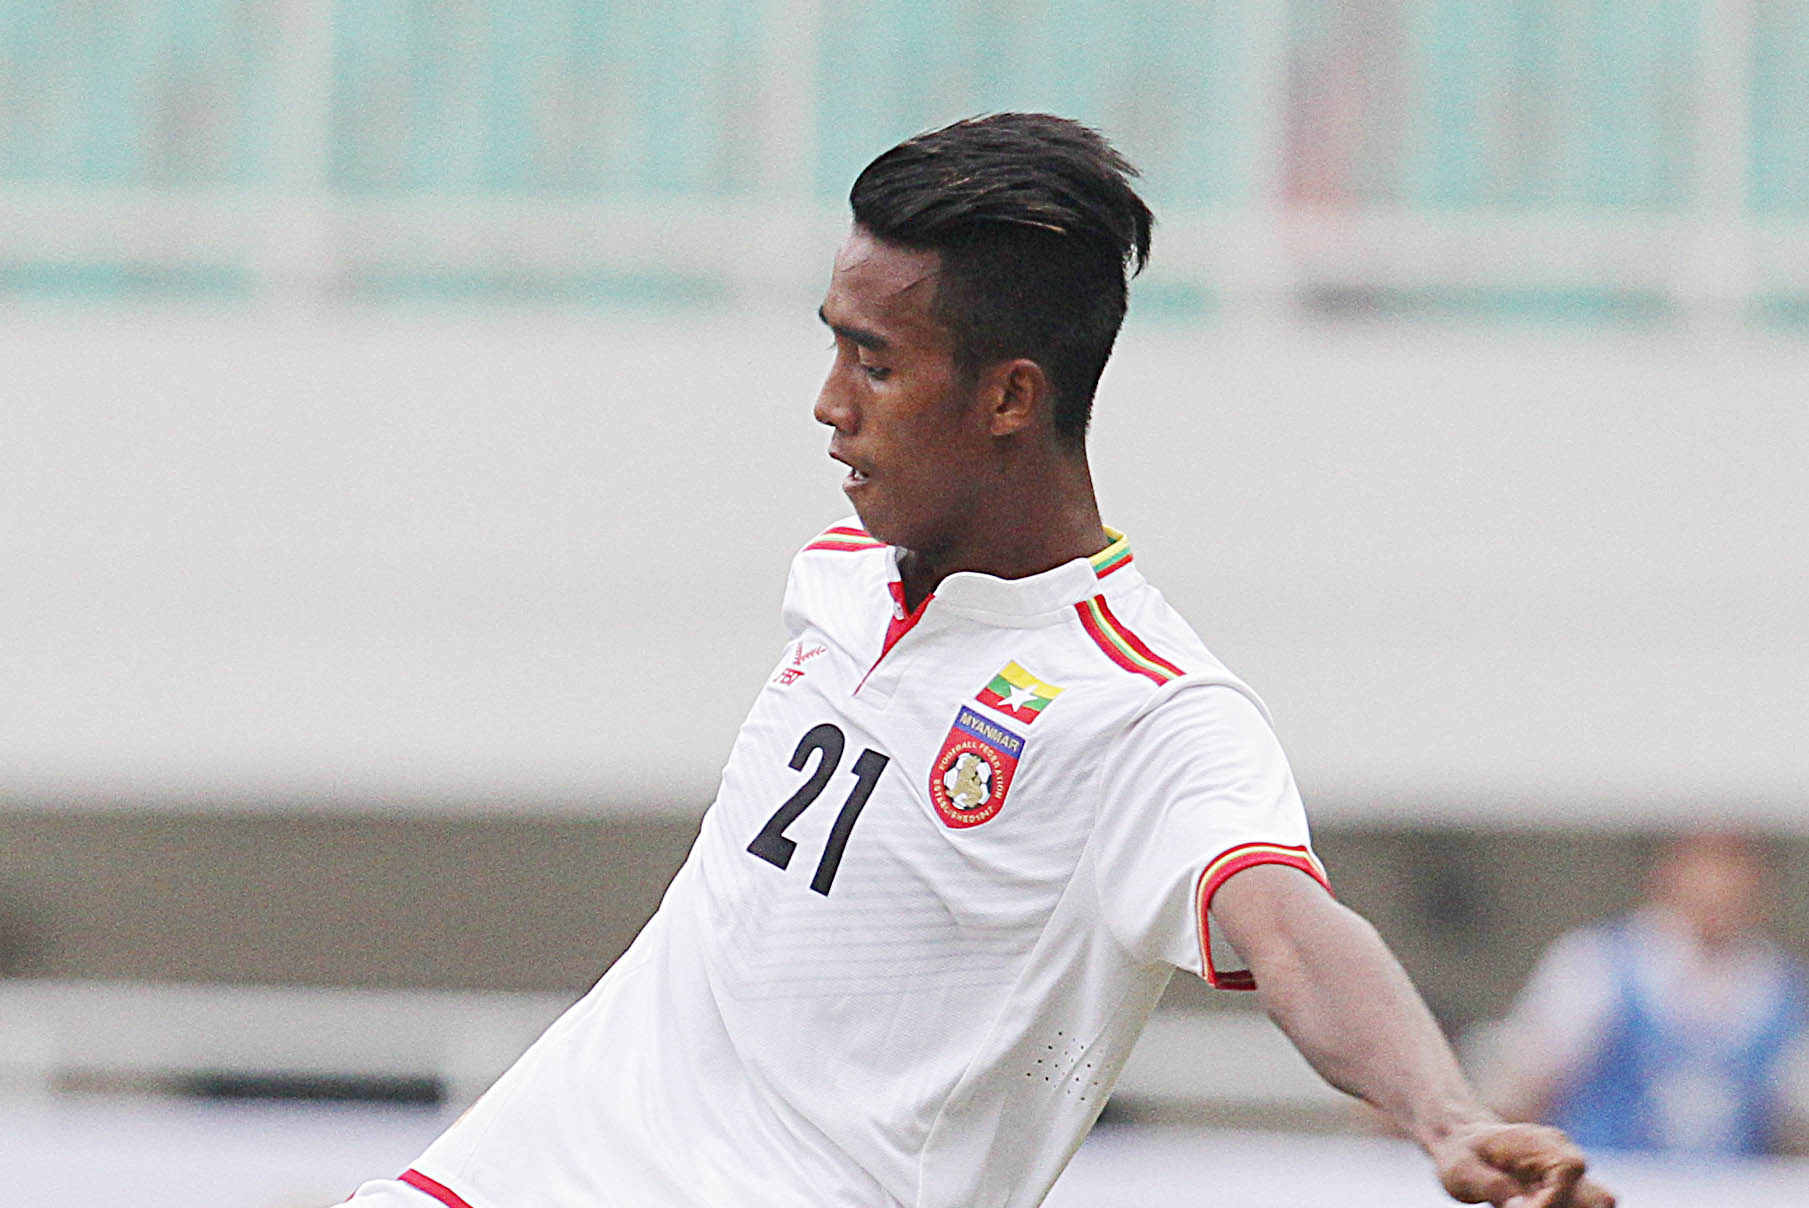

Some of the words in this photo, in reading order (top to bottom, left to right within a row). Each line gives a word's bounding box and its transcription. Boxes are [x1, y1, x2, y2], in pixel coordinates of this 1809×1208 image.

[959, 712, 1020, 752] MYANMAR
[938, 740, 978, 771] FOOTBALL
[747, 723, 891, 897] 21
